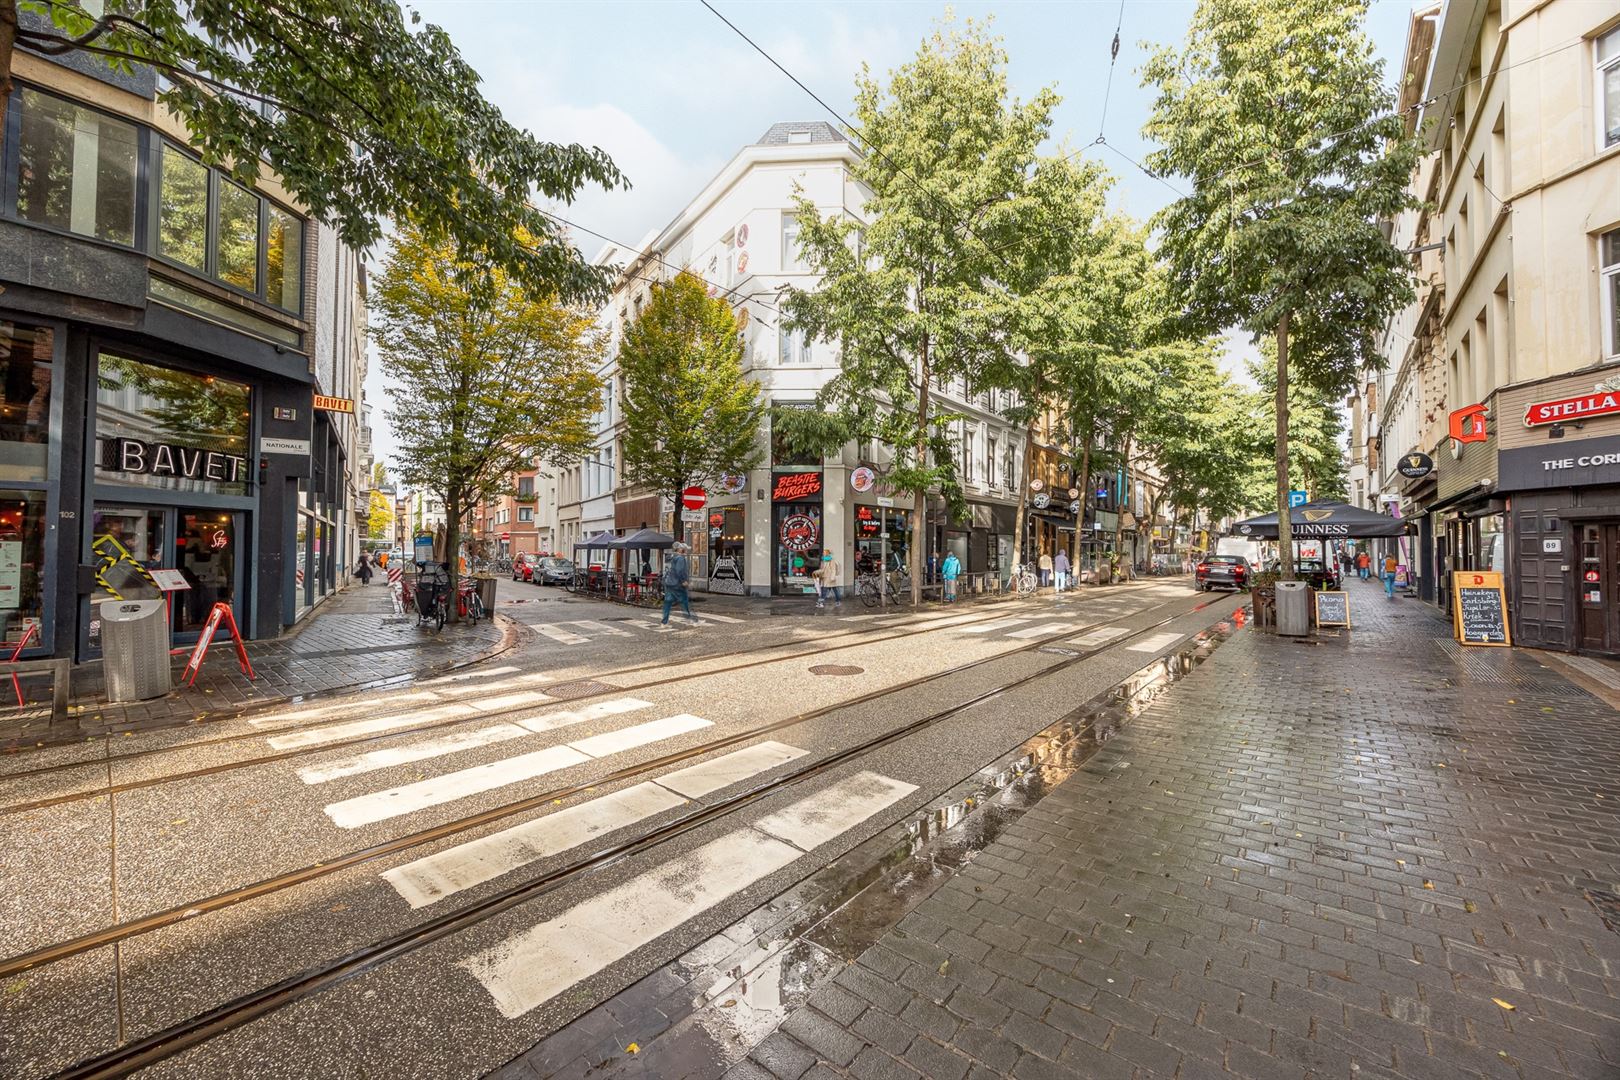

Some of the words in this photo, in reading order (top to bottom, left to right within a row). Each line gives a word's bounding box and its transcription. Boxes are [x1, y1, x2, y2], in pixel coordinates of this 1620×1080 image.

[316, 396, 348, 410] BAVET
[1540, 396, 1616, 418] STELLA
[122, 441, 245, 482] BAVET
[1541, 458, 1574, 470] THE
[778, 473, 819, 487] BEASTIE
[773, 482, 821, 499] BURGERS
[1291, 494, 1304, 508] P
[60, 511, 75, 519] 102
[1291, 524, 1349, 535] UINNESS
